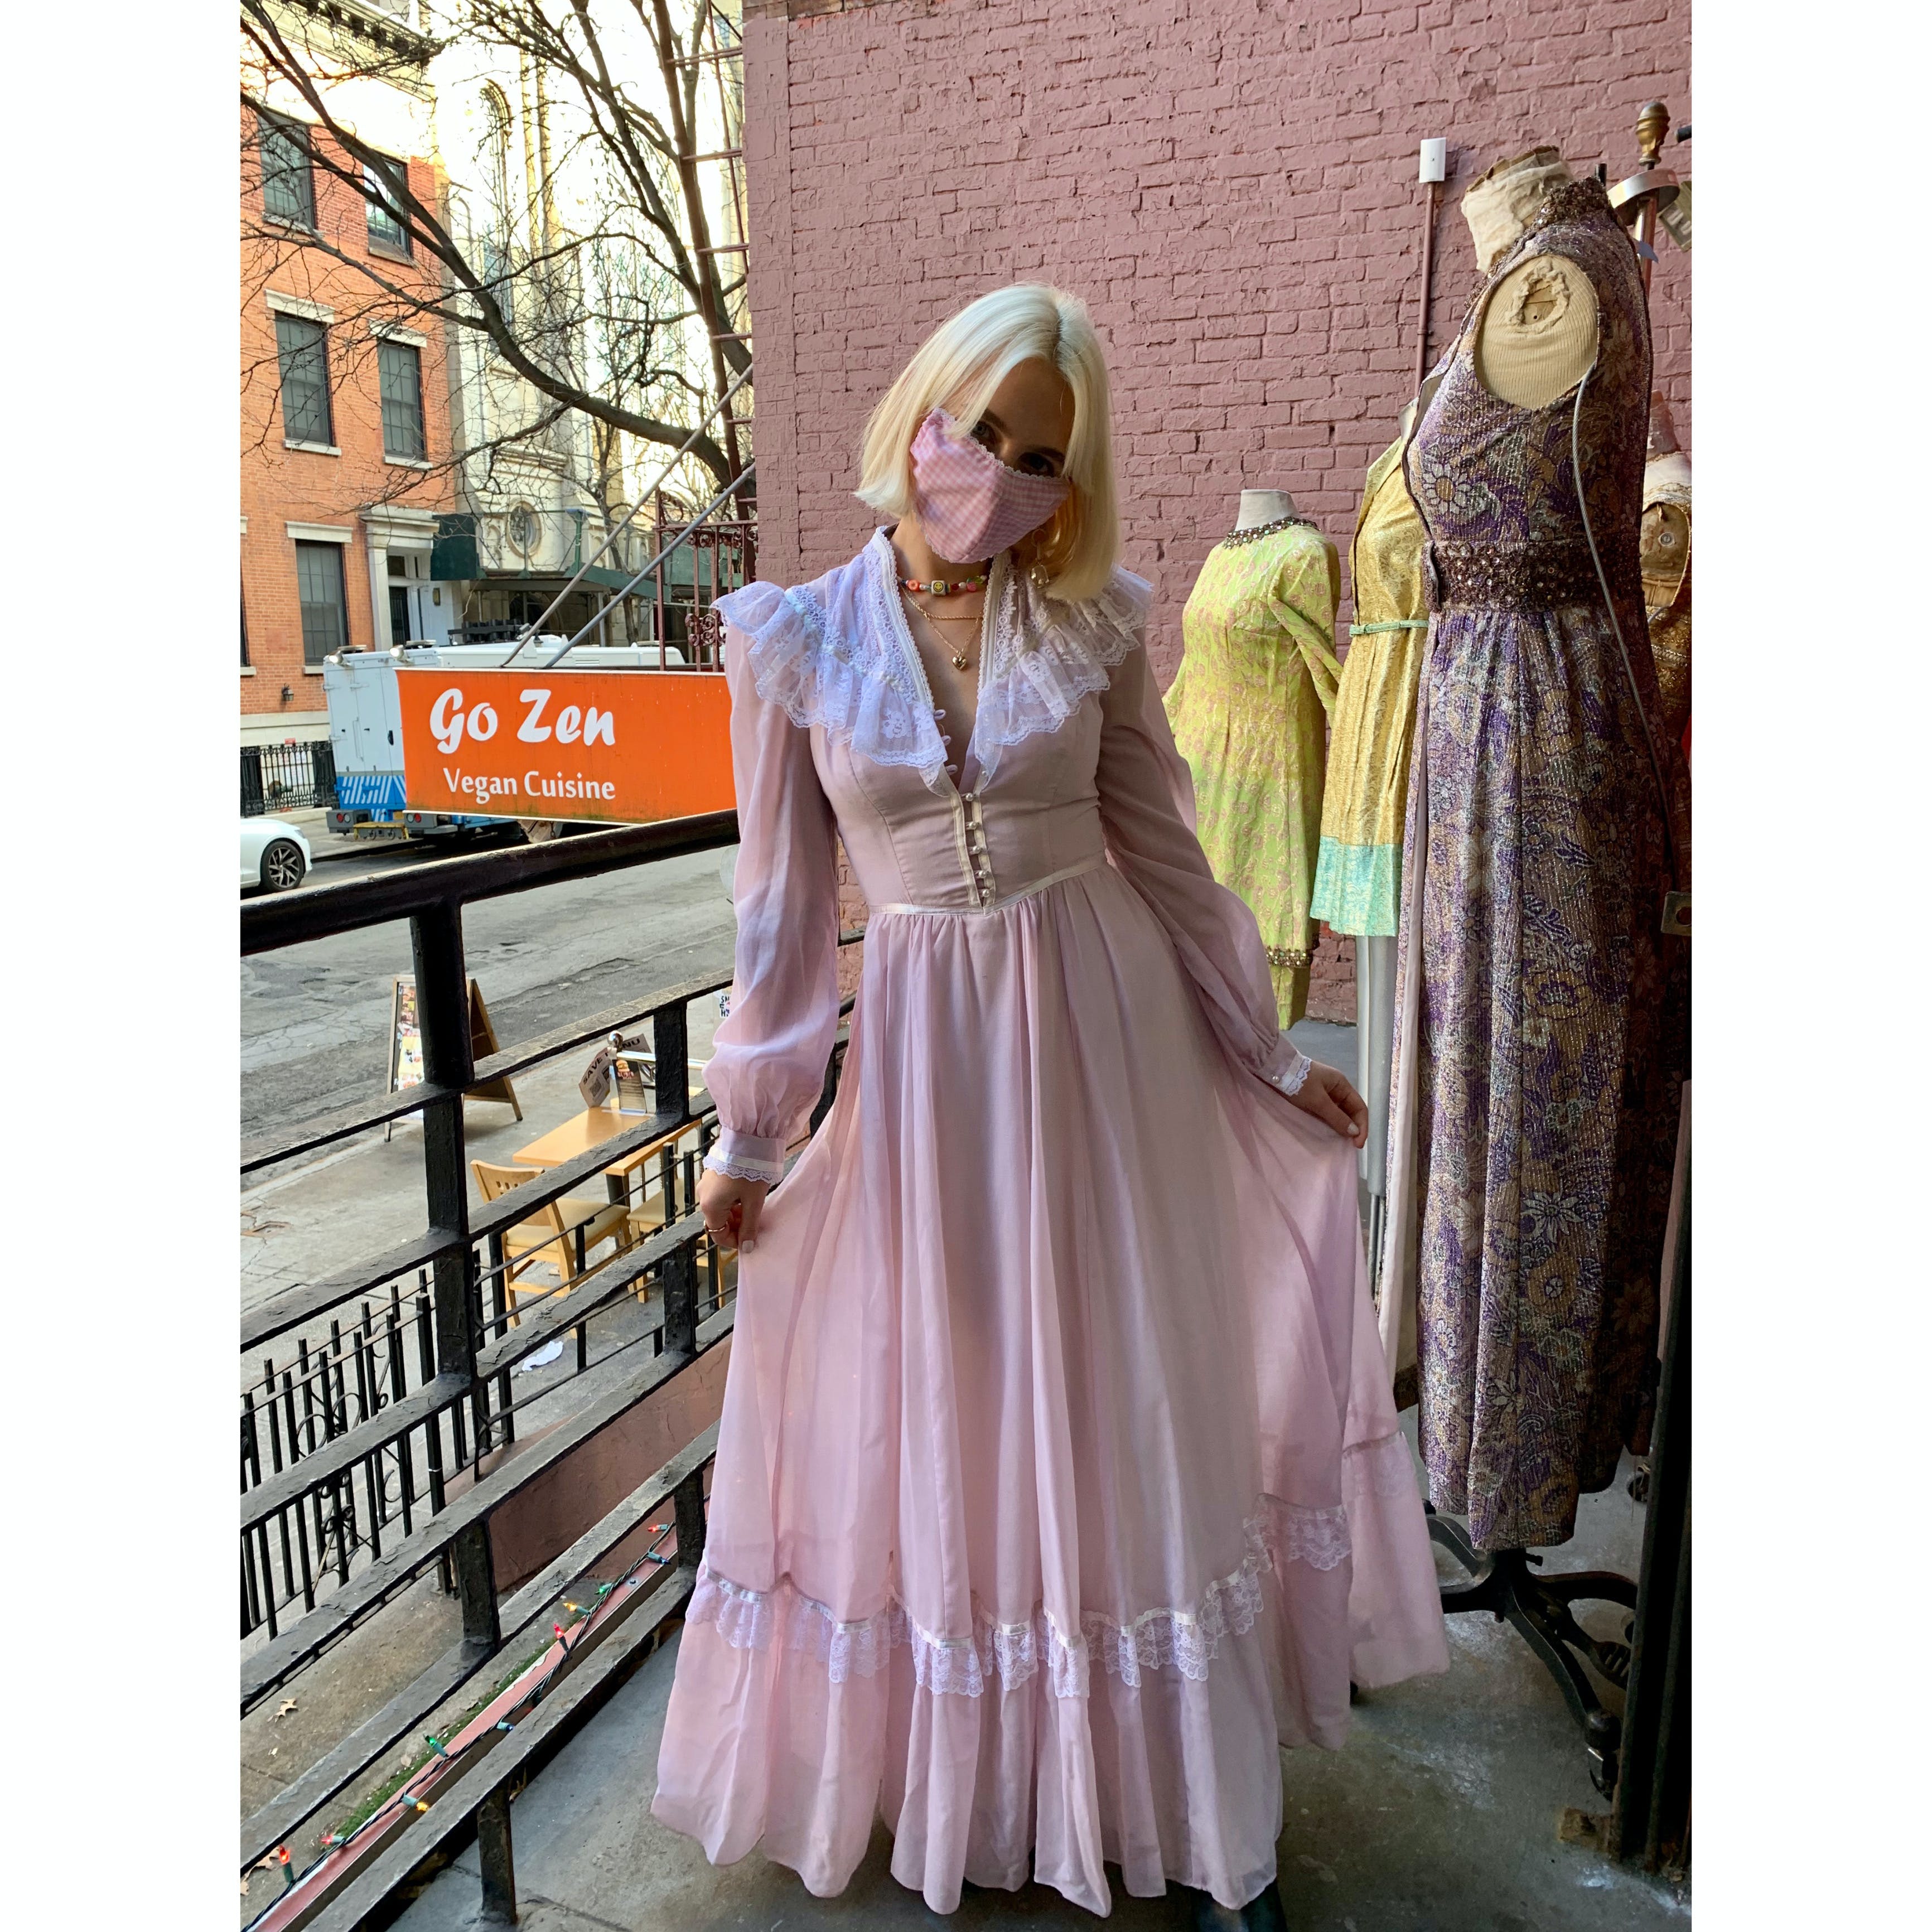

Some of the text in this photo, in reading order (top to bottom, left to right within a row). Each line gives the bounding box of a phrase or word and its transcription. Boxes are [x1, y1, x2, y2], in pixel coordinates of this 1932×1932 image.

[429, 688, 615, 754] Go Zen
[443, 767, 616, 804] Vegan Cuisine
